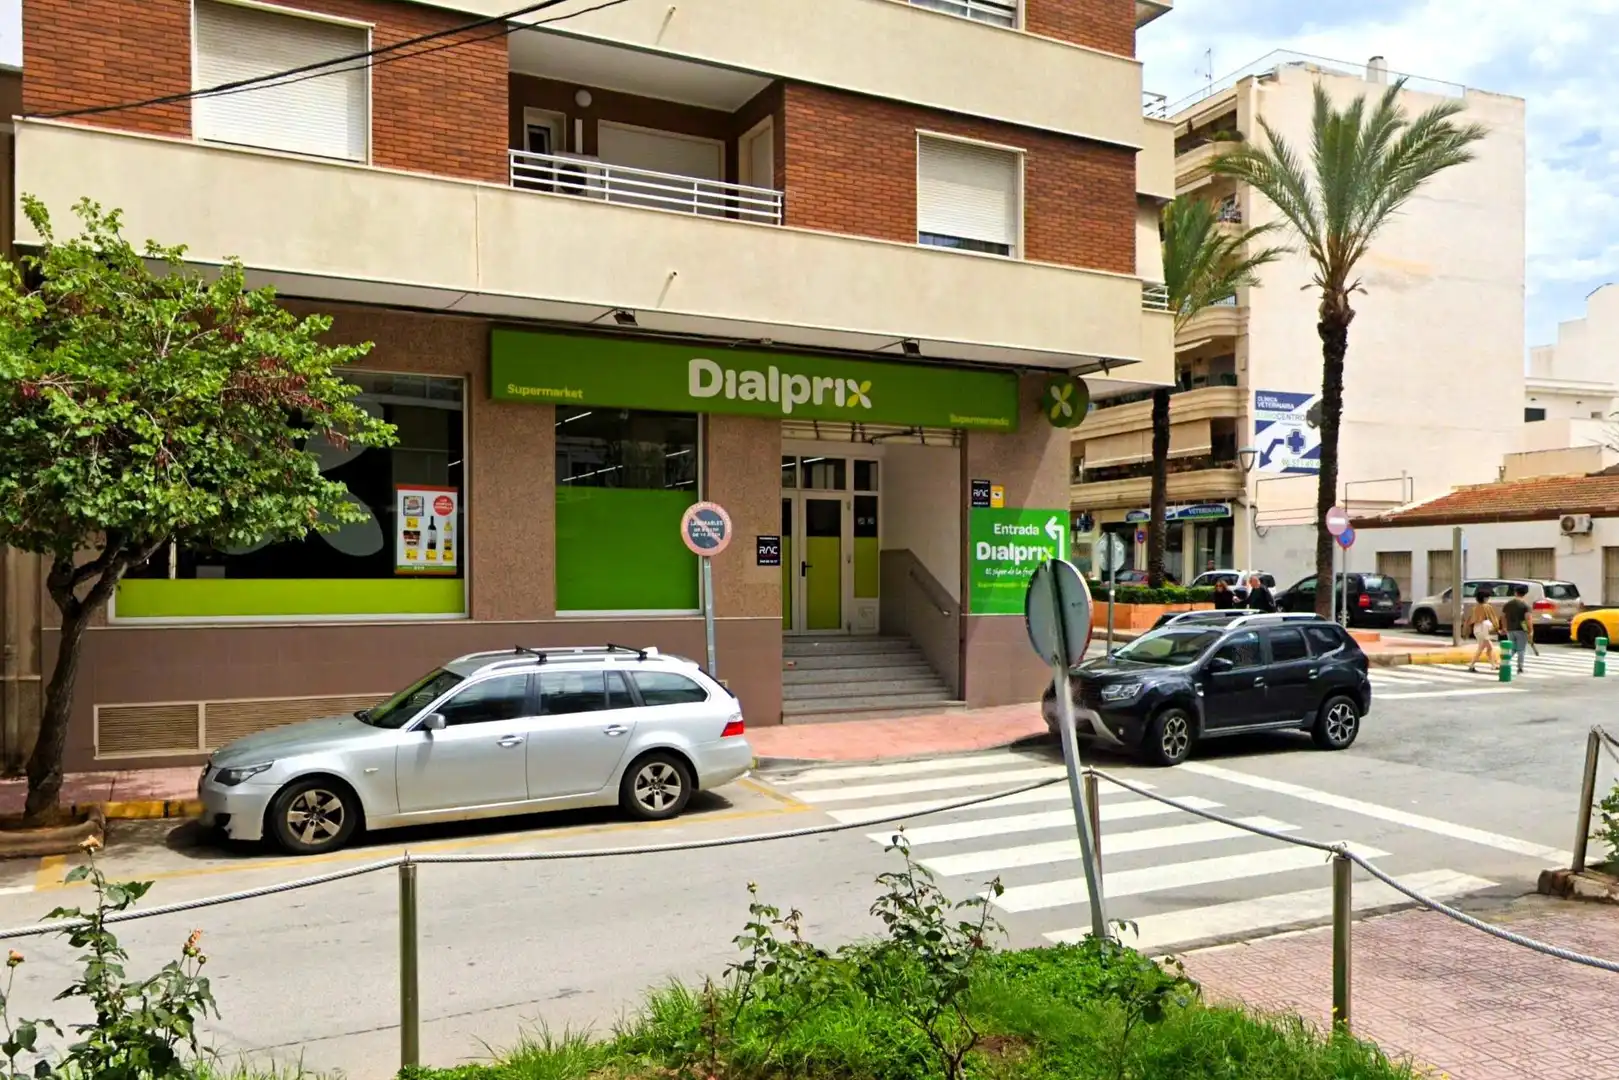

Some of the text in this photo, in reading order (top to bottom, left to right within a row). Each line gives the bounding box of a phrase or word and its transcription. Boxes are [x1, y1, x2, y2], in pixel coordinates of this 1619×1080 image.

[507, 383, 584, 400] Supermarket
[688, 358, 873, 414] Dialprix
[1257, 401, 1295, 409] VETERINARIA
[993, 523, 1040, 535] Entrada
[976, 541, 1055, 565] Dialprix
